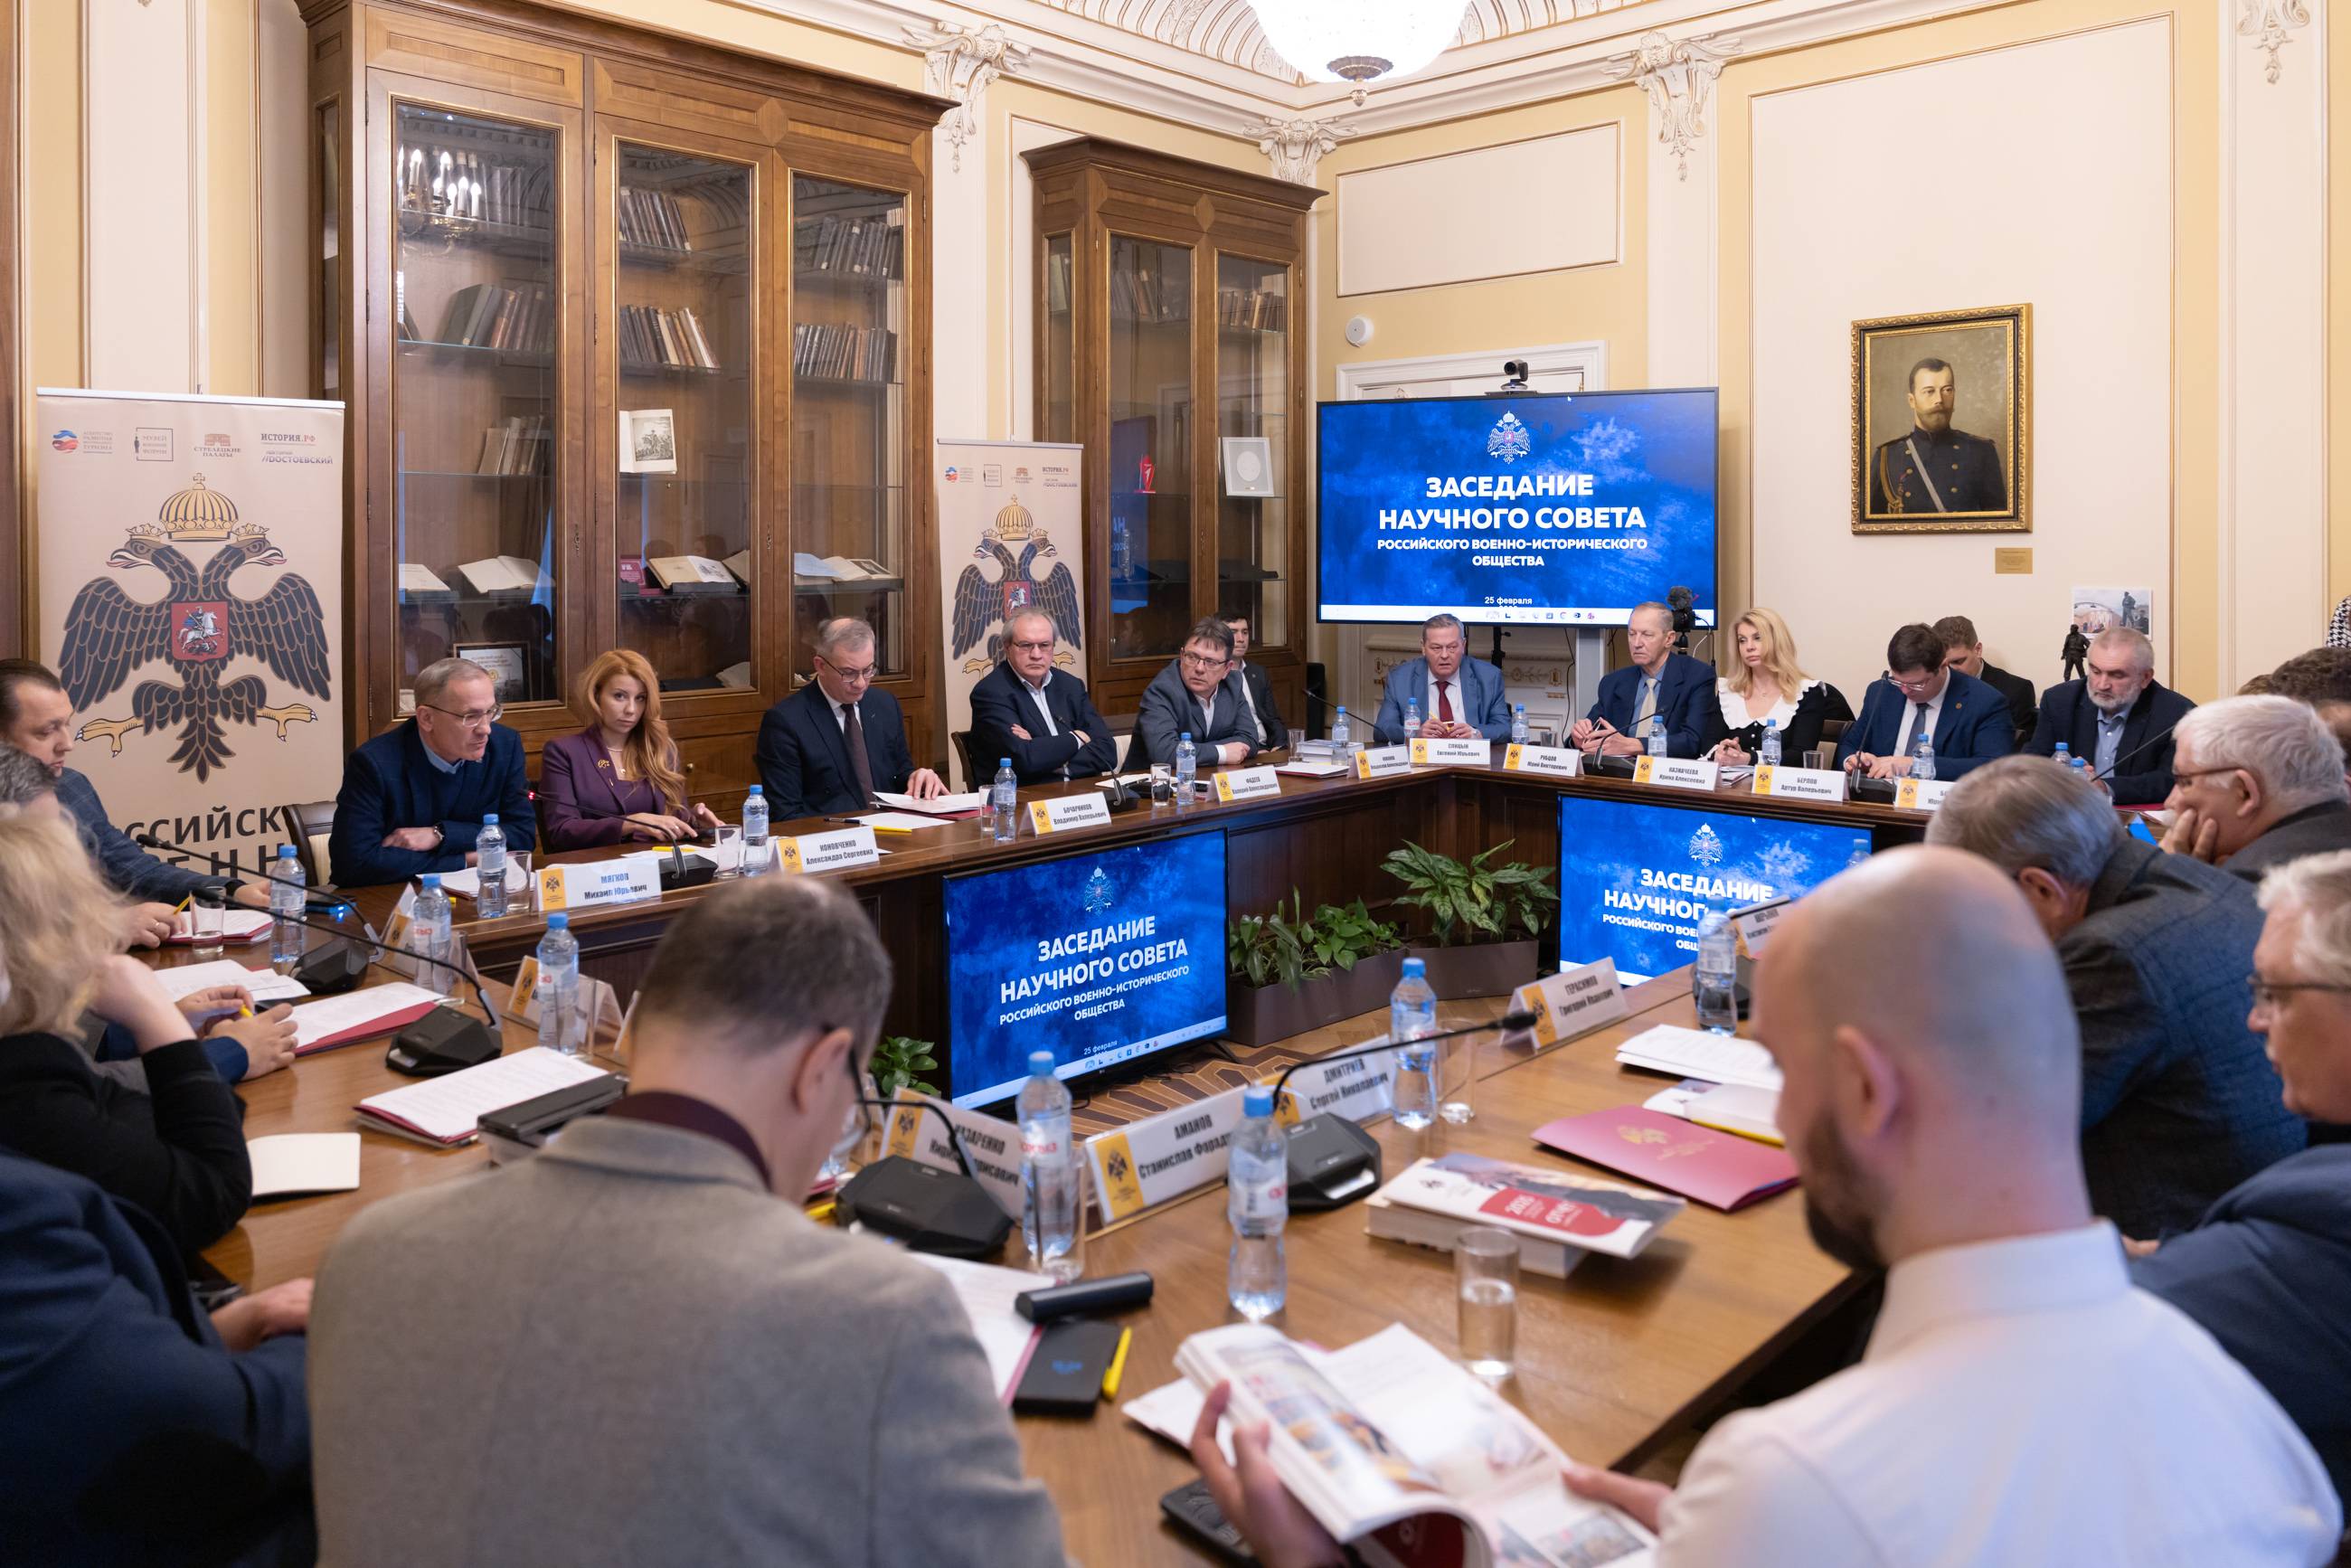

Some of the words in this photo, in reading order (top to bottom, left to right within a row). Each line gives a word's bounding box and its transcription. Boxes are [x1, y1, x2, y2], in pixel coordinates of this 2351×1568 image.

[260, 433, 316, 442] ИСТОРИЯ.РФ
[1426, 474, 1593, 500] ЗАСЕДАНИЕ
[1379, 507, 1529, 530] НАУЧНОГО
[1535, 505, 1647, 529] СОВЕТА
[1377, 536, 1469, 550] РОССИЙСКОГО
[1472, 537, 1648, 550] ВОЕННО-ИСТОРИЧЕСКОГО
[1472, 555, 1544, 567] ОБЩЕСТВА
[1497, 597, 1532, 605] февраля
[806, 853, 843, 865] Александра
[843, 849, 873, 860] Сергеевна
[819, 840, 856, 852] КОНОВЧЕНКО
[600, 873, 629, 883] МЯГКОВ
[1640, 869, 1773, 902] ЗАСЕДАНИЕ
[584, 889, 612, 900] Михаил
[1604, 890, 1709, 920] НАУЧНОГ
[1602, 914, 1674, 934] РОССИЙСКОГО
[1038, 916, 1156, 962] ЗАСЕДАНИЕ
[1000, 957, 1114, 1004] НАУЧНОГО
[1118, 938, 1188, 972] СОВЕТА
[1000, 997, 1072, 1025] РОССИЙСКОГО
[1074, 965, 1189, 1005] ВОЕННО-ИСТОРИЧЕСКОГО
[1074, 998, 1125, 1021] ОБЩЕСТВА
[1084, 1046, 1091, 1055] 25
[1092, 1039, 1117, 1054] февраля
[1324, 1058, 1365, 1083] ДМИТРИЕВ
[1309, 1088, 1340, 1110] Сергей
[1174, 1114, 1213, 1140] АМАНОВ
[1138, 1148, 1194, 1180] Станислав
